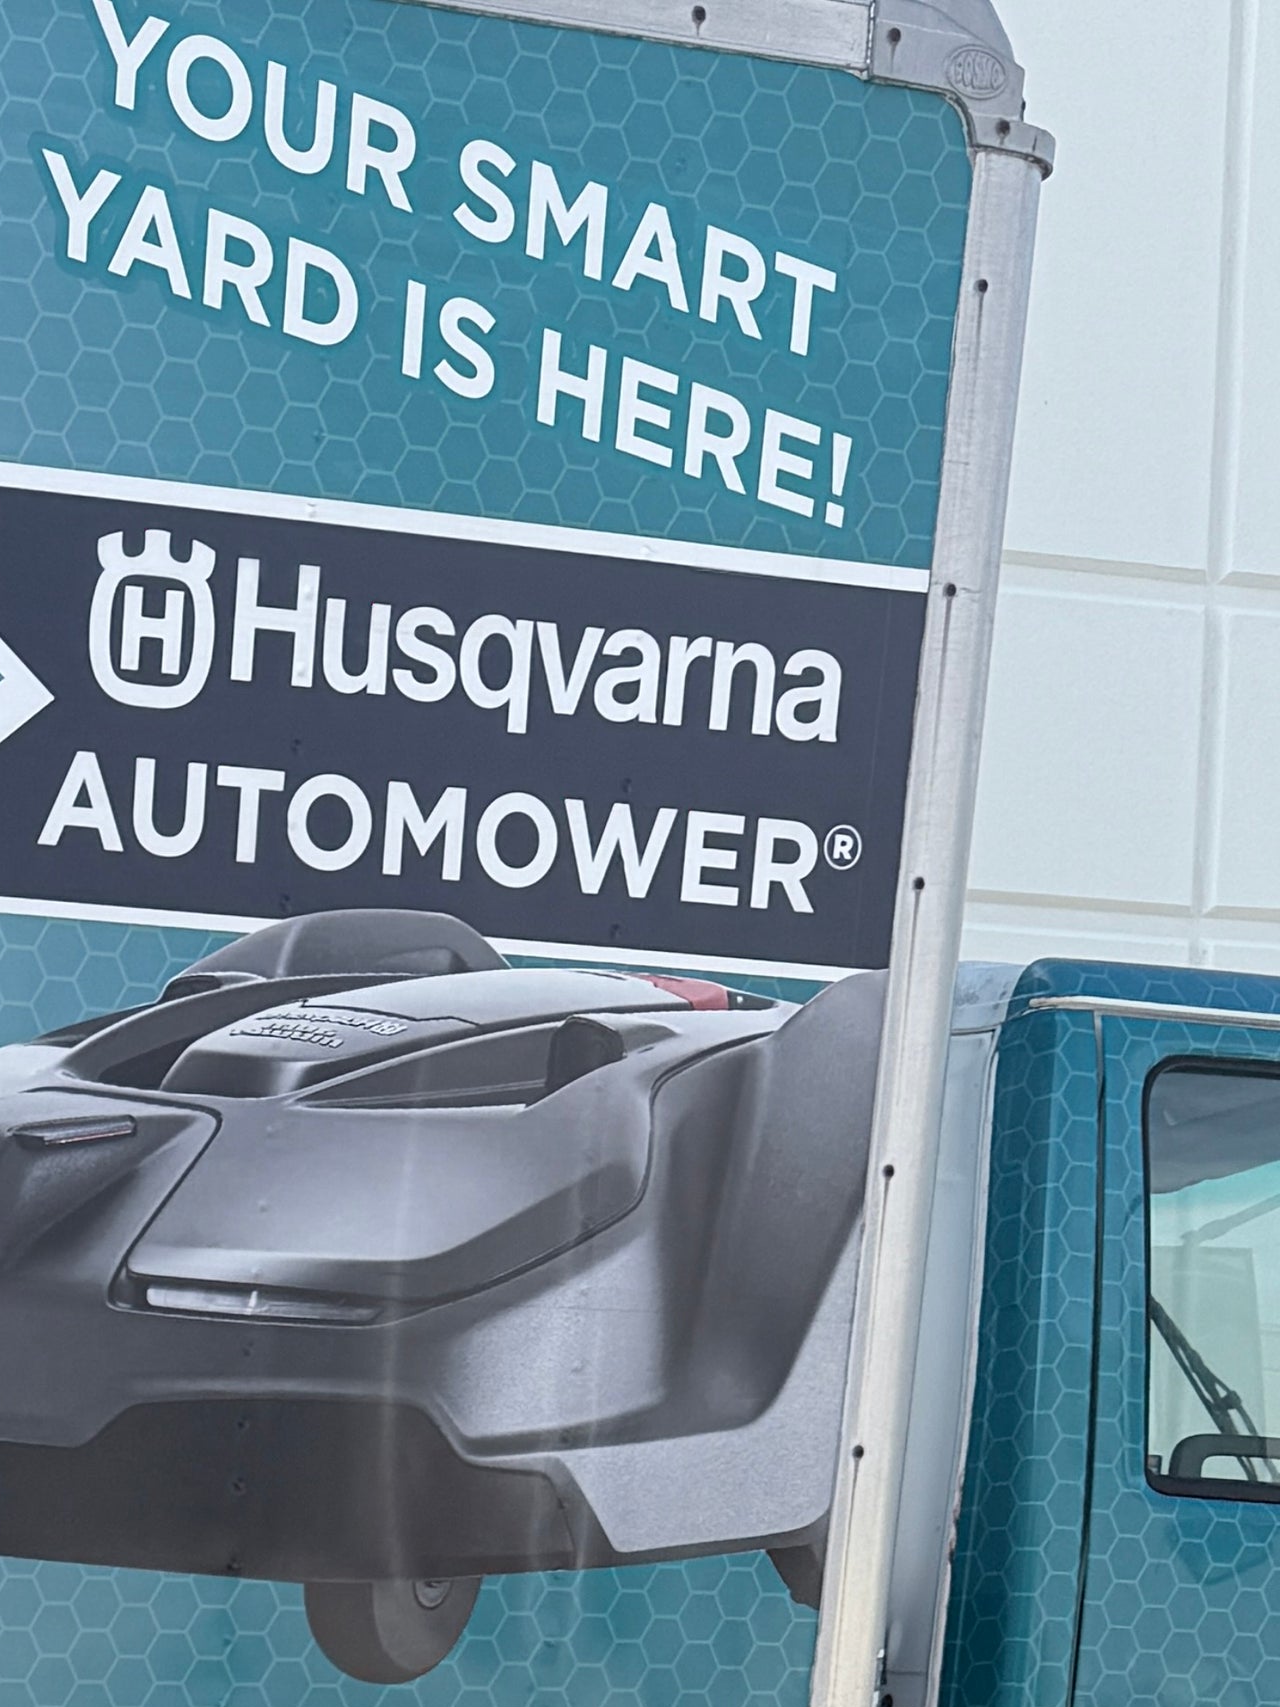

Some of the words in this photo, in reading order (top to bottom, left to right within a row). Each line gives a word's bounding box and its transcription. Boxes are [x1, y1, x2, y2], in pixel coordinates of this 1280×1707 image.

[42, 149, 358, 345] YARD
[402, 280, 496, 399] IS
[537, 328, 853, 528] HERE!
[93, 0, 415, 212] YOUR
[453, 141, 836, 356] SMART
[230, 557, 842, 742] Husqvarna
